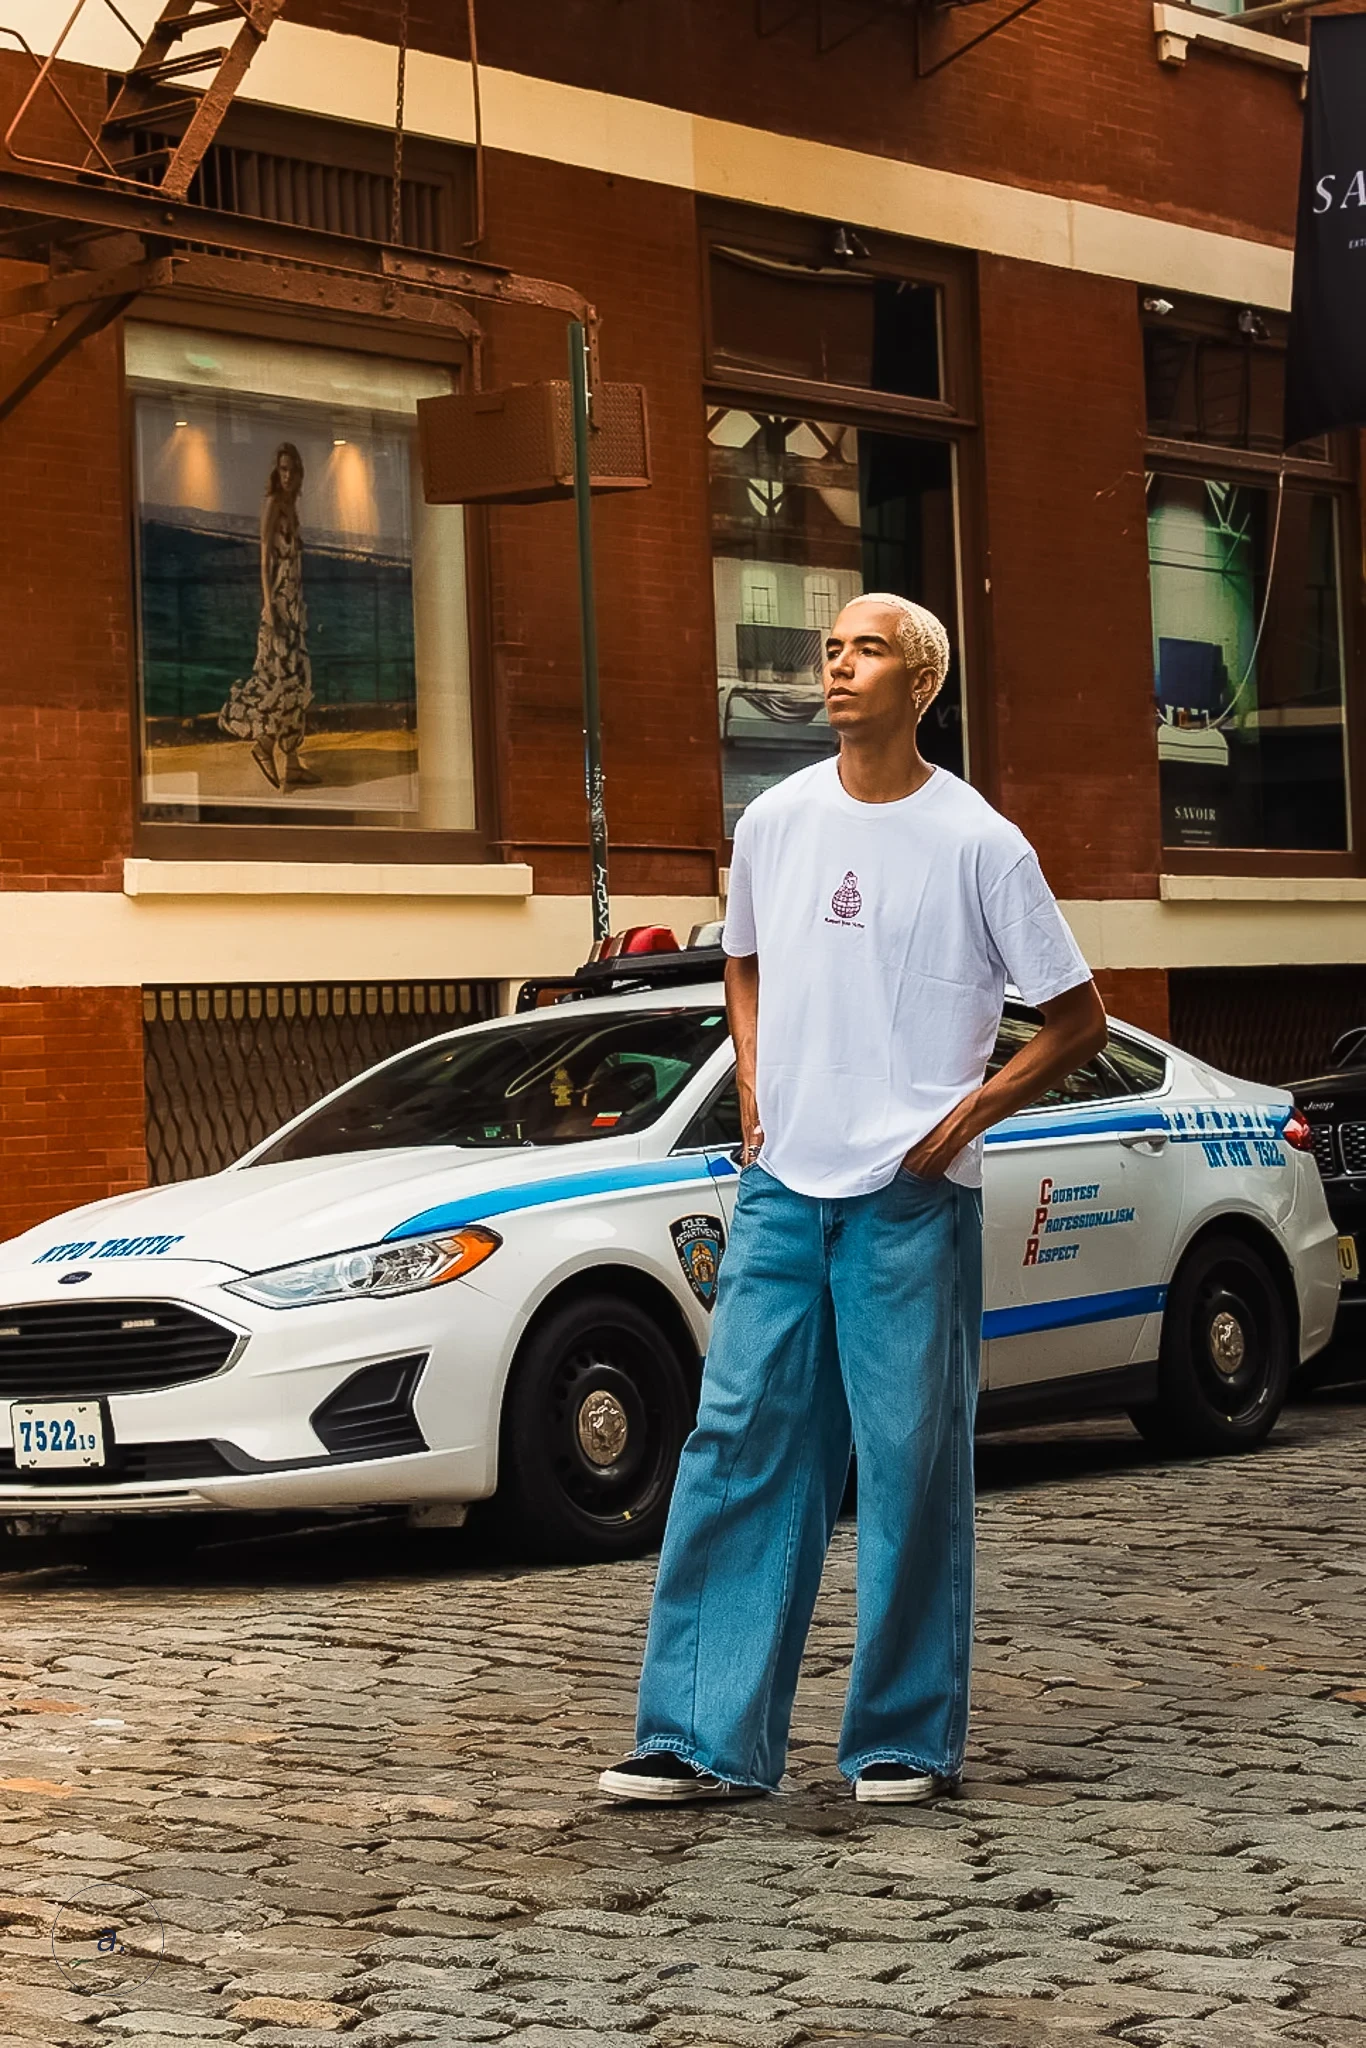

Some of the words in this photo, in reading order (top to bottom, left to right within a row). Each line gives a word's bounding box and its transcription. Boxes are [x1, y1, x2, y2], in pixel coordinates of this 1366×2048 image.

[1174, 806, 1217, 821] SAVOIR
[1303, 1101, 1334, 1111] Jeep
[1158, 1104, 1276, 1139] TRAFFIC
[681, 1218, 708, 1230] POLICE
[676, 1227, 720, 1248] DEPARTMENT
[31, 1241, 97, 1265] NYPD
[88, 1235, 186, 1259] TRAFFIC
